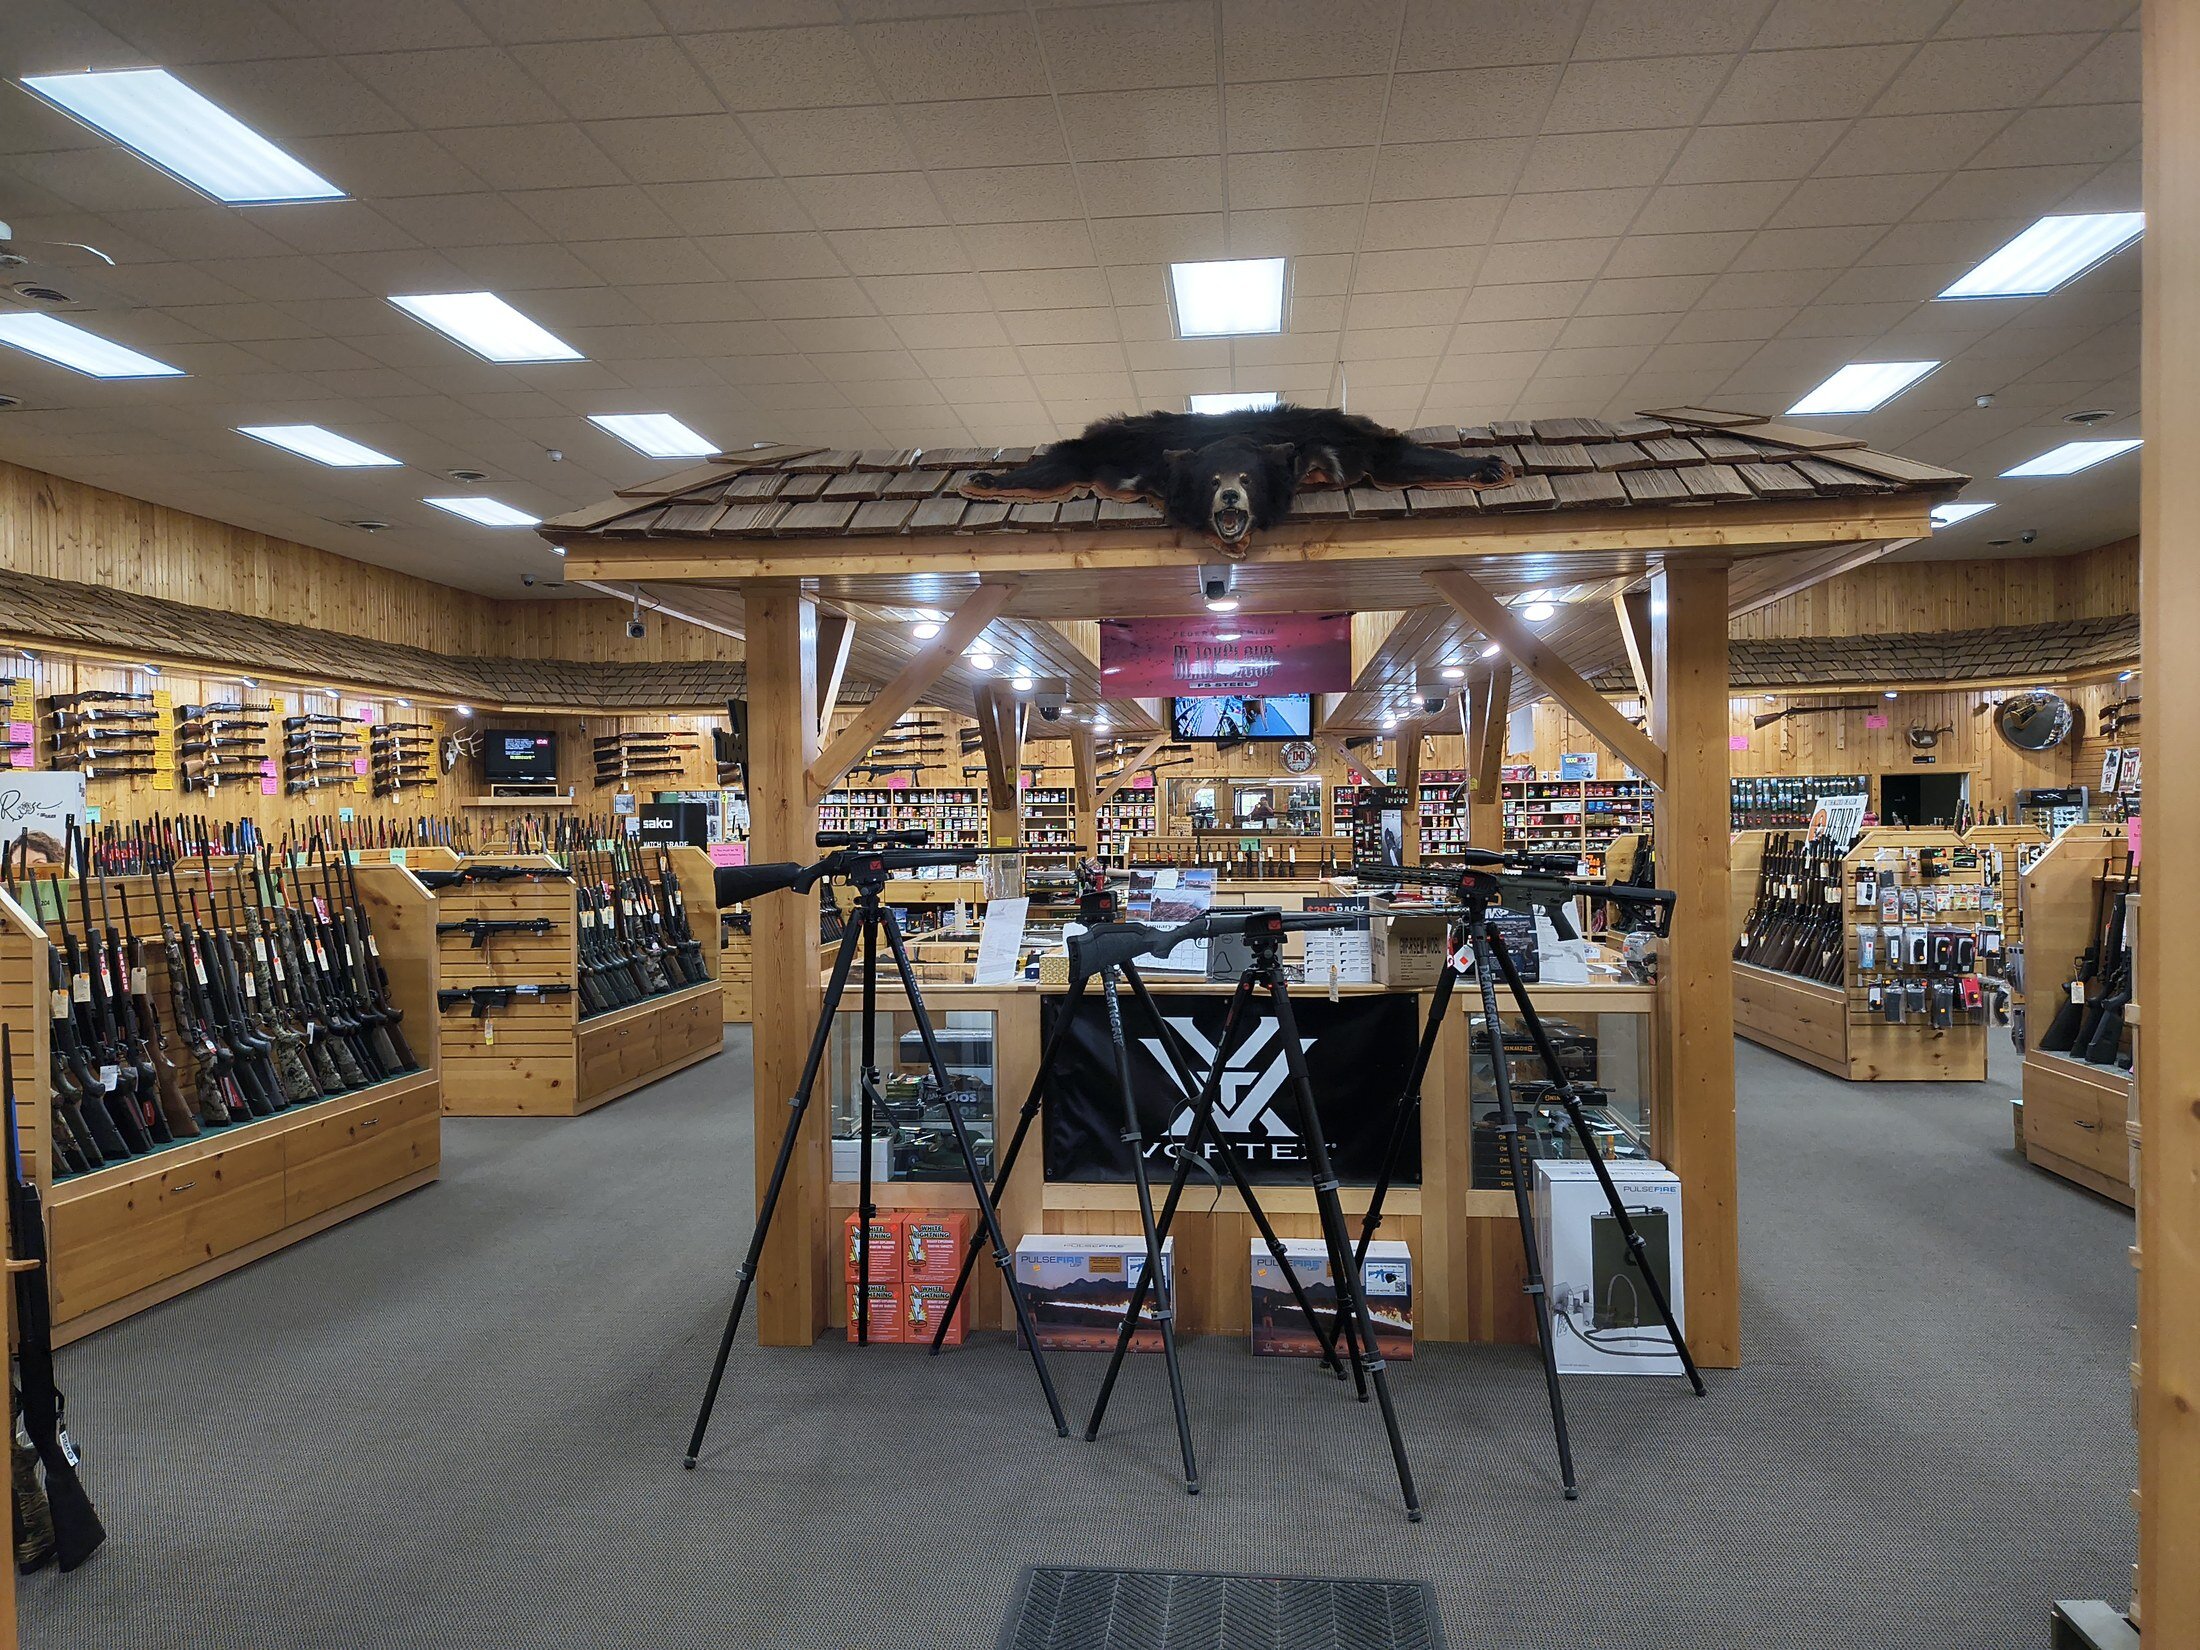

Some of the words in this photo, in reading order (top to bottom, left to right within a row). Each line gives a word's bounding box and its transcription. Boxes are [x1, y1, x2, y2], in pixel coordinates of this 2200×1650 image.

[642, 816, 674, 829] sako
[118, 952, 129, 991] SAVAGE
[1479, 964, 1500, 1035] DEATHGRIP
[1623, 1185, 1677, 1193] PULSEFIRE
[921, 1224, 943, 1232] WHITE
[1020, 1255, 1083, 1265] PULSEFIRE
[922, 1285, 944, 1293] WHITE
